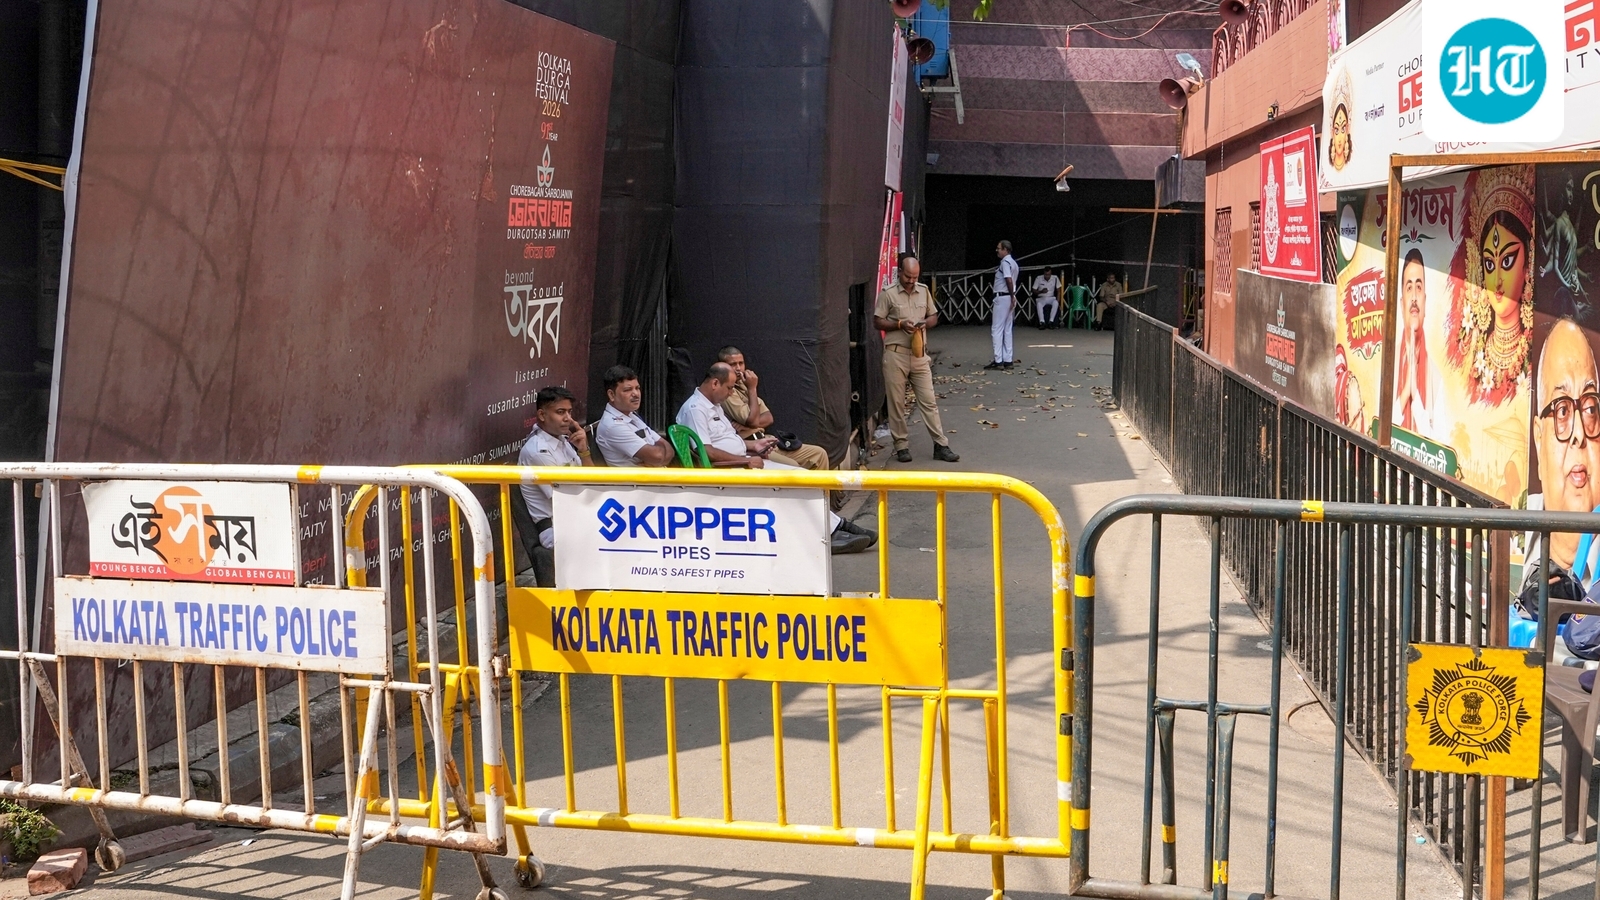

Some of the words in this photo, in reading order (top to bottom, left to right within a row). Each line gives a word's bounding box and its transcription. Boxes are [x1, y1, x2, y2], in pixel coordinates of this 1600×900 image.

[537, 51, 572, 75] KOLKATA
[536, 66, 571, 90] DURGA
[535, 83, 569, 105] FESTIVAL
[541, 100, 561, 118] 2026
[548, 132, 558, 141] YEAR
[510, 184, 544, 198] CHOREBAGAN
[544, 187, 573, 199] SARBOJANIN
[507, 228, 547, 240] DURGOTSAB
[548, 229, 571, 239] SAMITY
[504, 268, 534, 286] beyond
[533, 281, 564, 299] sound
[504, 284, 564, 359] অরব
[1351, 306, 1384, 340] অভিনন্দ
[514, 366, 549, 384] listener
[487, 396, 520, 417] susanta
[488, 442, 512, 461] SUMAN
[111, 494, 168, 564] এই
[597, 497, 777, 543] SKIPPER
[661, 545, 711, 560] PIPES
[94, 562, 128, 572] YOUNG
[130, 564, 168, 574] BENGAL
[205, 567, 243, 578] GLOBAL
[246, 568, 291, 580] BENGALI
[630, 565, 668, 578] INDIA'S
[670, 566, 712, 580] SAFEST
[713, 567, 746, 581] PIPES
[72, 597, 170, 646] KOLKATA
[175, 601, 268, 652] TRAFFIC
[276, 606, 358, 658] POLICE
[551, 606, 661, 655] KOLKATA
[667, 609, 770, 660] TRAFFIC
[777, 613, 867, 663] POLICE
[1438, 682, 1464, 715] KOLKATA
[1465, 679, 1496, 697] POLICE
[1495, 693, 1508, 722] FORCE
